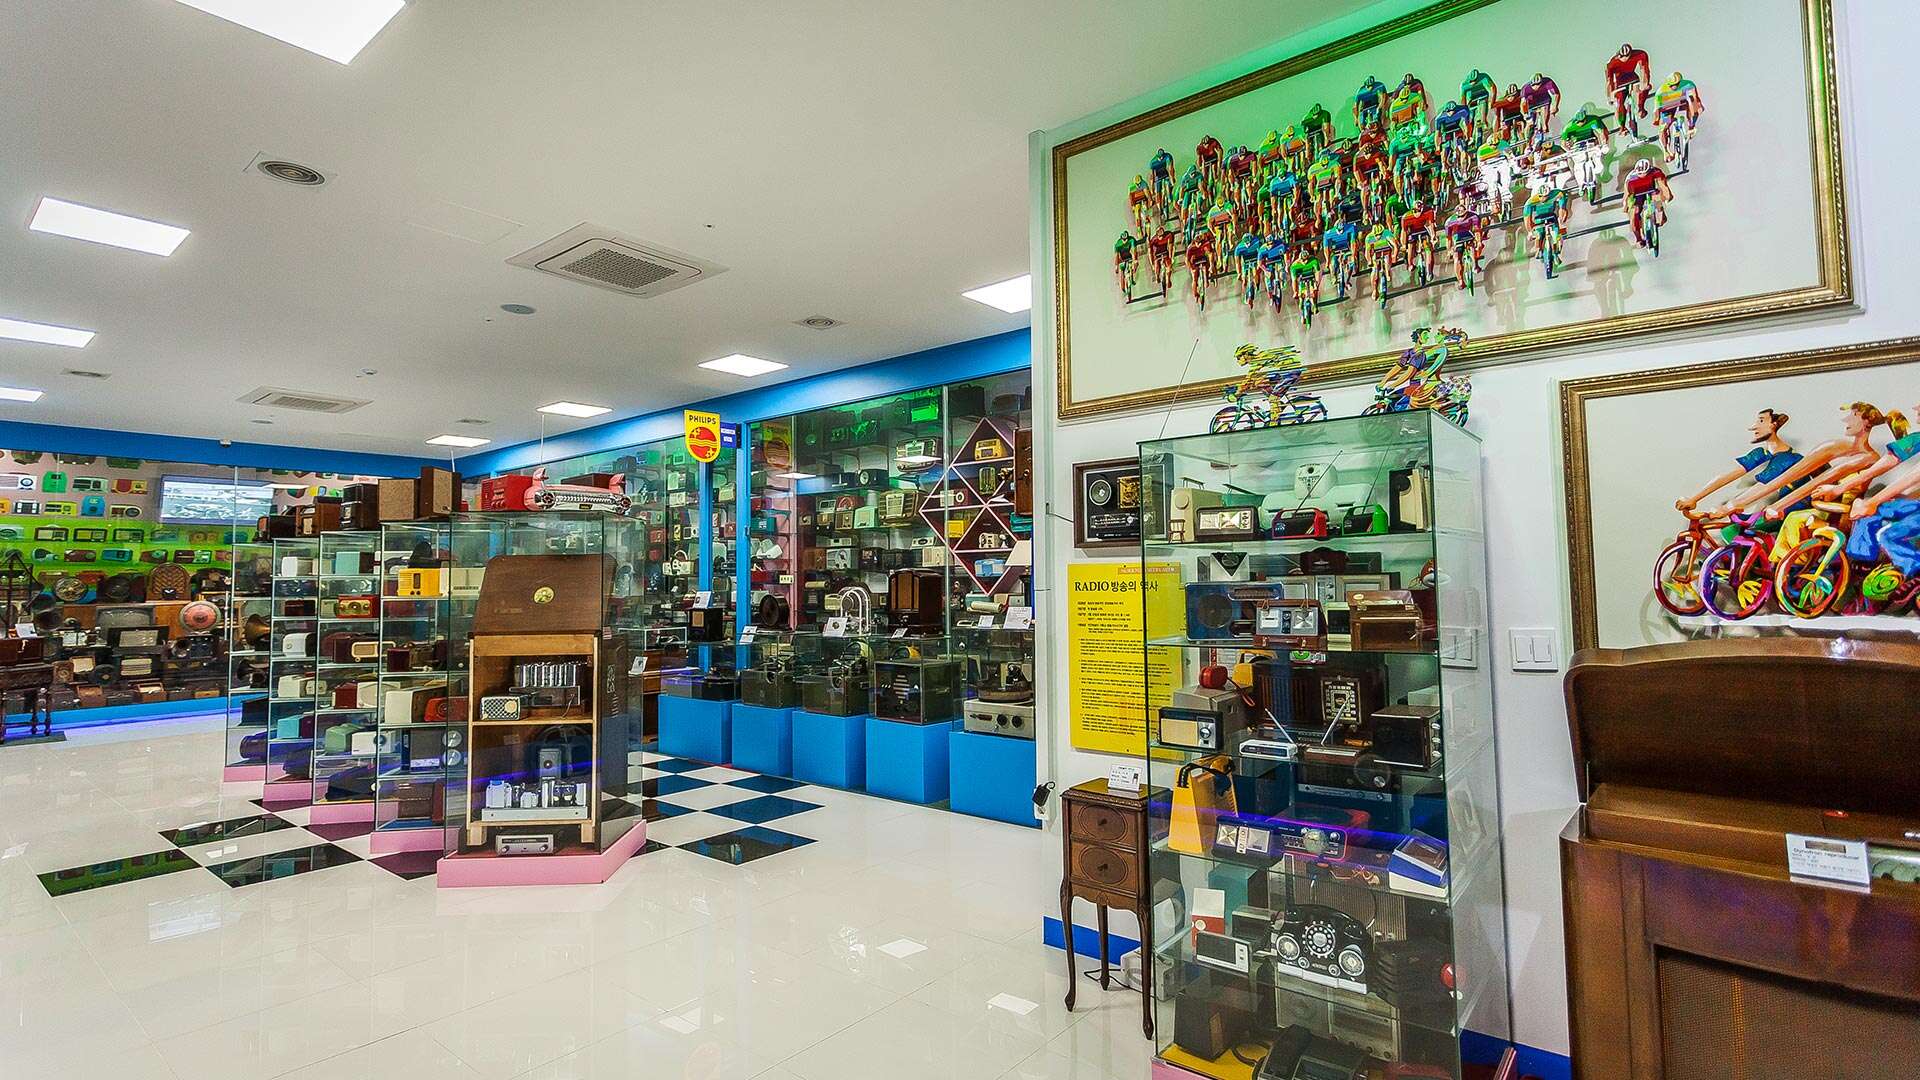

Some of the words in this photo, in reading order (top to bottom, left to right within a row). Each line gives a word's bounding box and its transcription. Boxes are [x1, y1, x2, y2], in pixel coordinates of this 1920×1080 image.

[688, 414, 717, 425] PHILIPS
[1074, 581, 1110, 592] RADIO
[1110, 580, 1137, 593] 방송의
